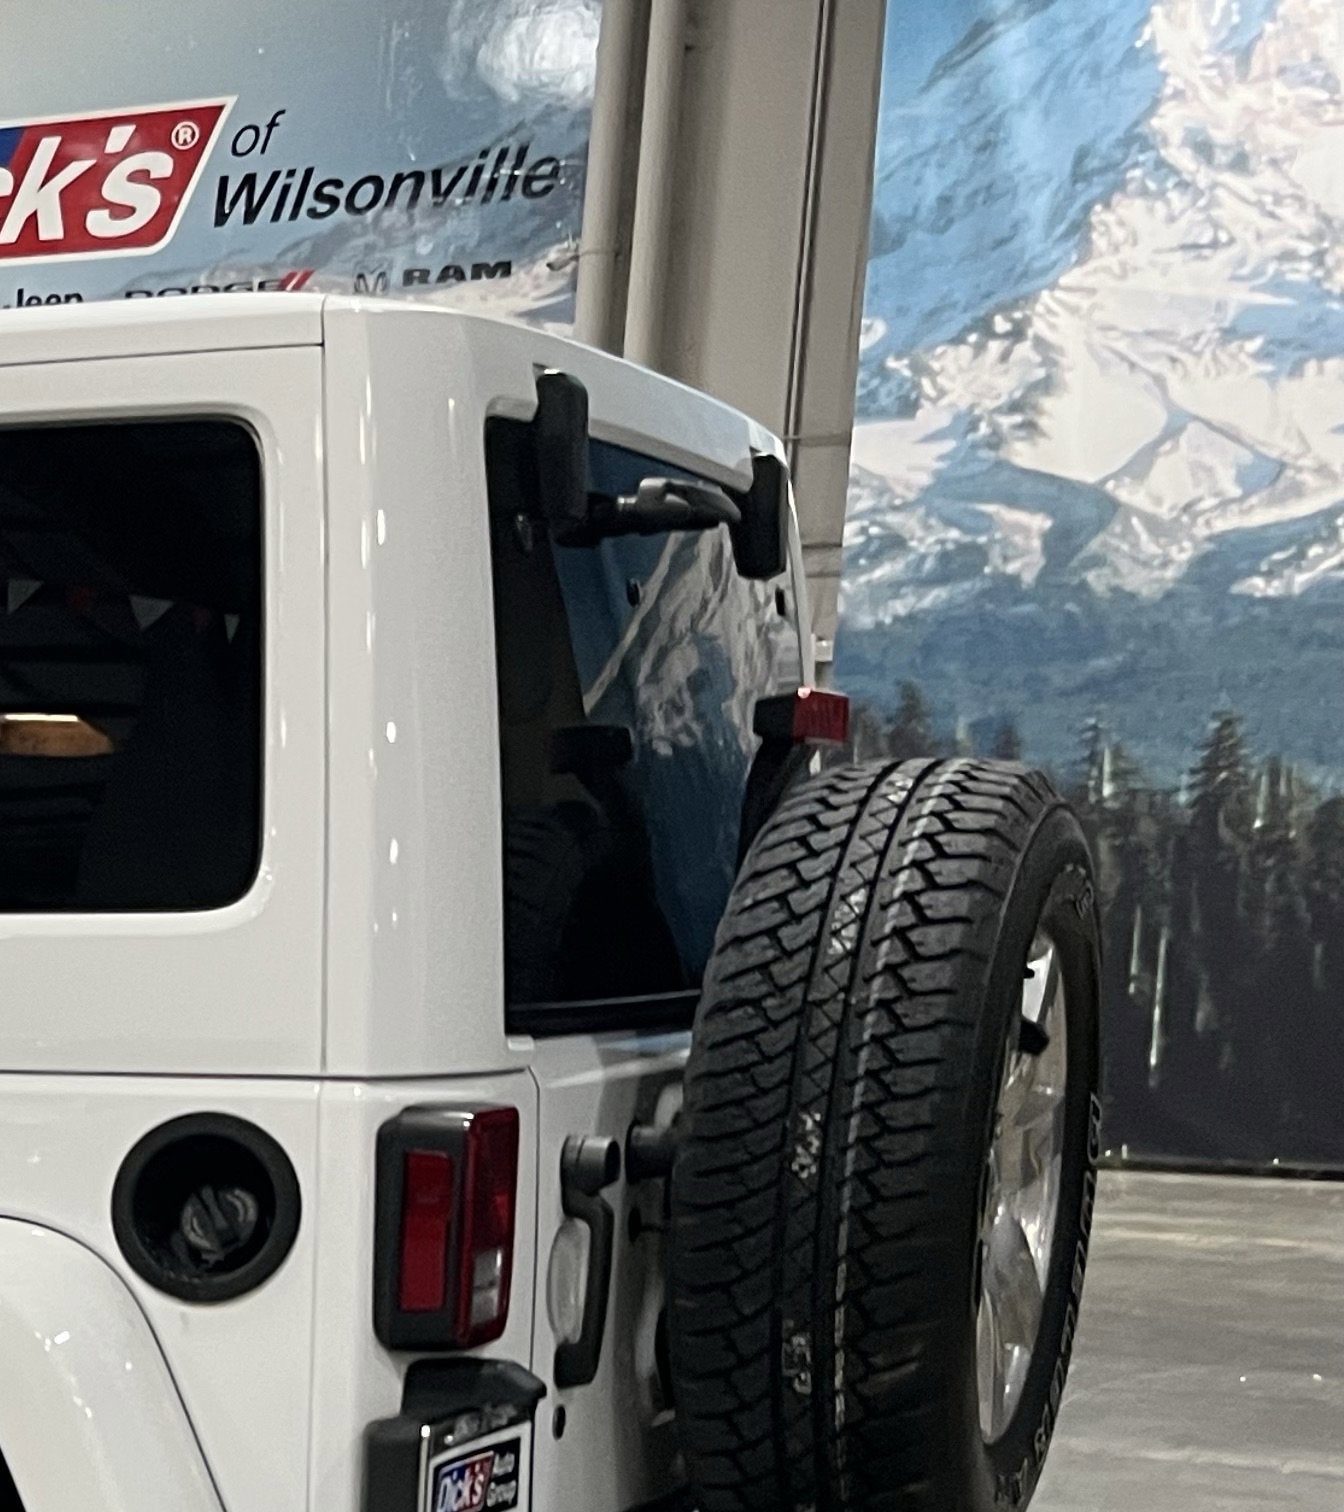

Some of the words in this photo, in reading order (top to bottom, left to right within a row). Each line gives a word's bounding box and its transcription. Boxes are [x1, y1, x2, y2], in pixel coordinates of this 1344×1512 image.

[231, 109, 286, 158] of
[213, 141, 561, 228] Wilsonville
[402, 260, 512, 287] RAM
